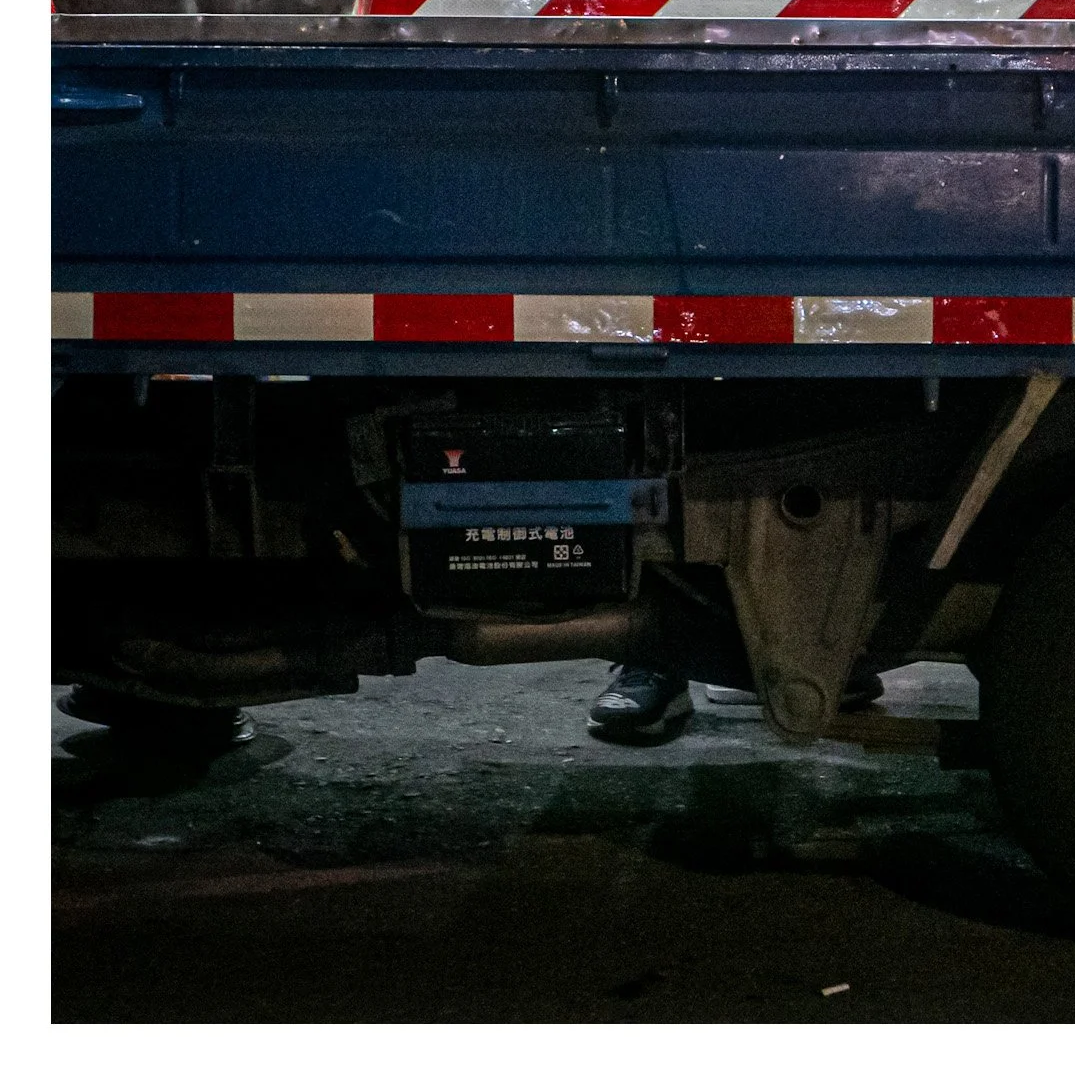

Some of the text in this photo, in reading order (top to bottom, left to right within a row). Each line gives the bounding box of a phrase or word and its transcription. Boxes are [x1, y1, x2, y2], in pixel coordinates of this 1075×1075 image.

[465, 527, 575, 542] 充電制御式電池
